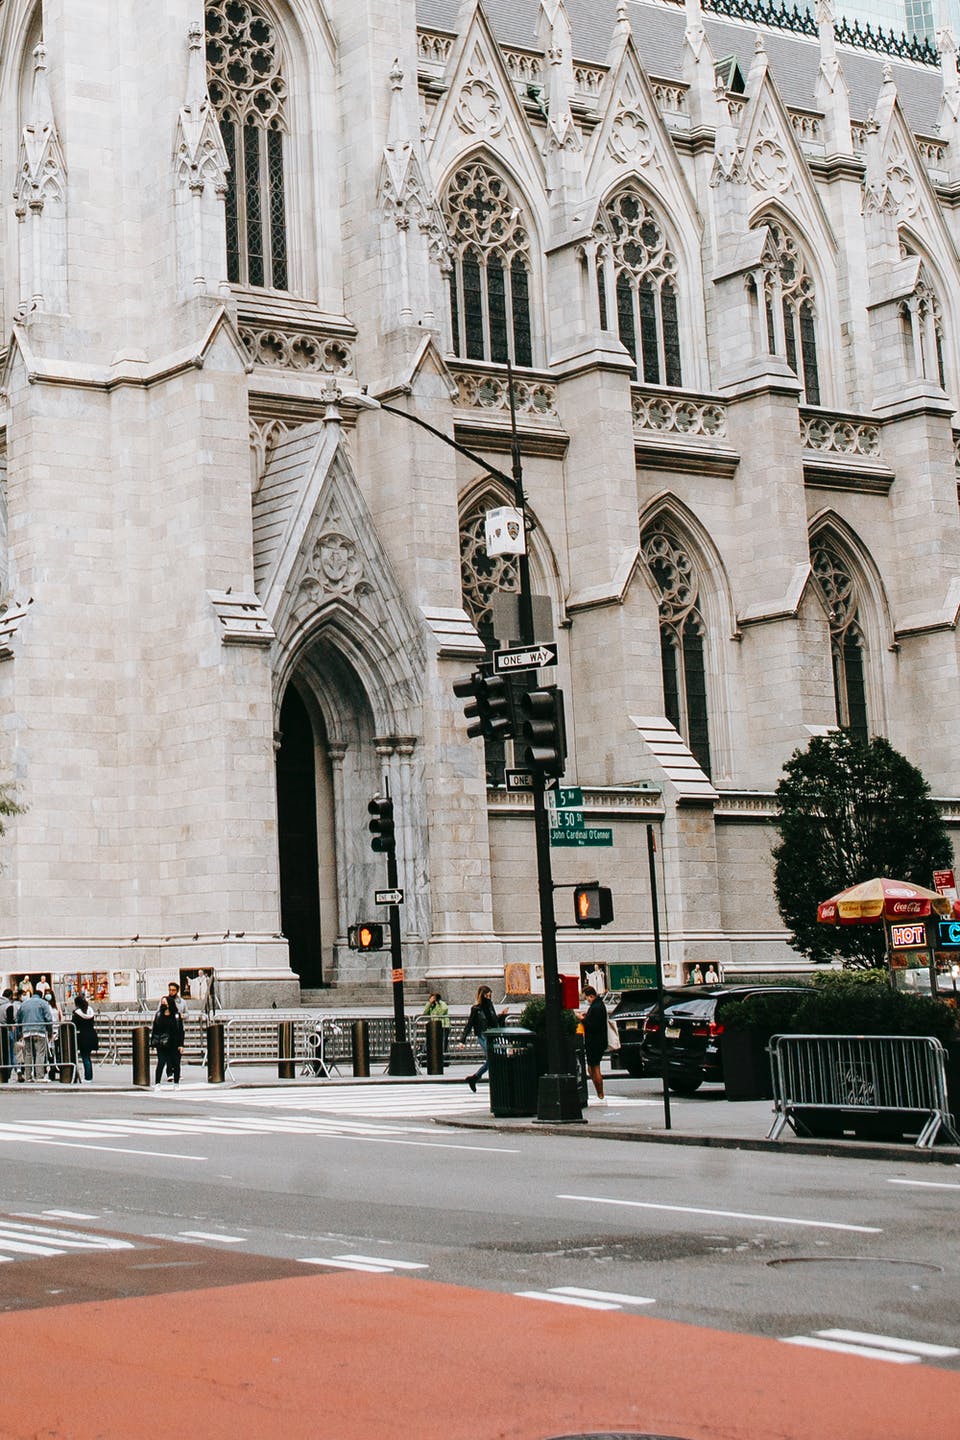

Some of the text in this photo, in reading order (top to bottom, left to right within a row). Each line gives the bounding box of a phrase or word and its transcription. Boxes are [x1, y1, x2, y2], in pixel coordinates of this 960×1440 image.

[503, 651, 548, 666] ONE WAY
[513, 775, 529, 785] ONE
[560, 791, 566, 806] 5
[557, 812, 583, 826] E 50 St
[552, 829, 610, 840] John Cardinal O'Connor
[893, 926, 923, 945] HOT
